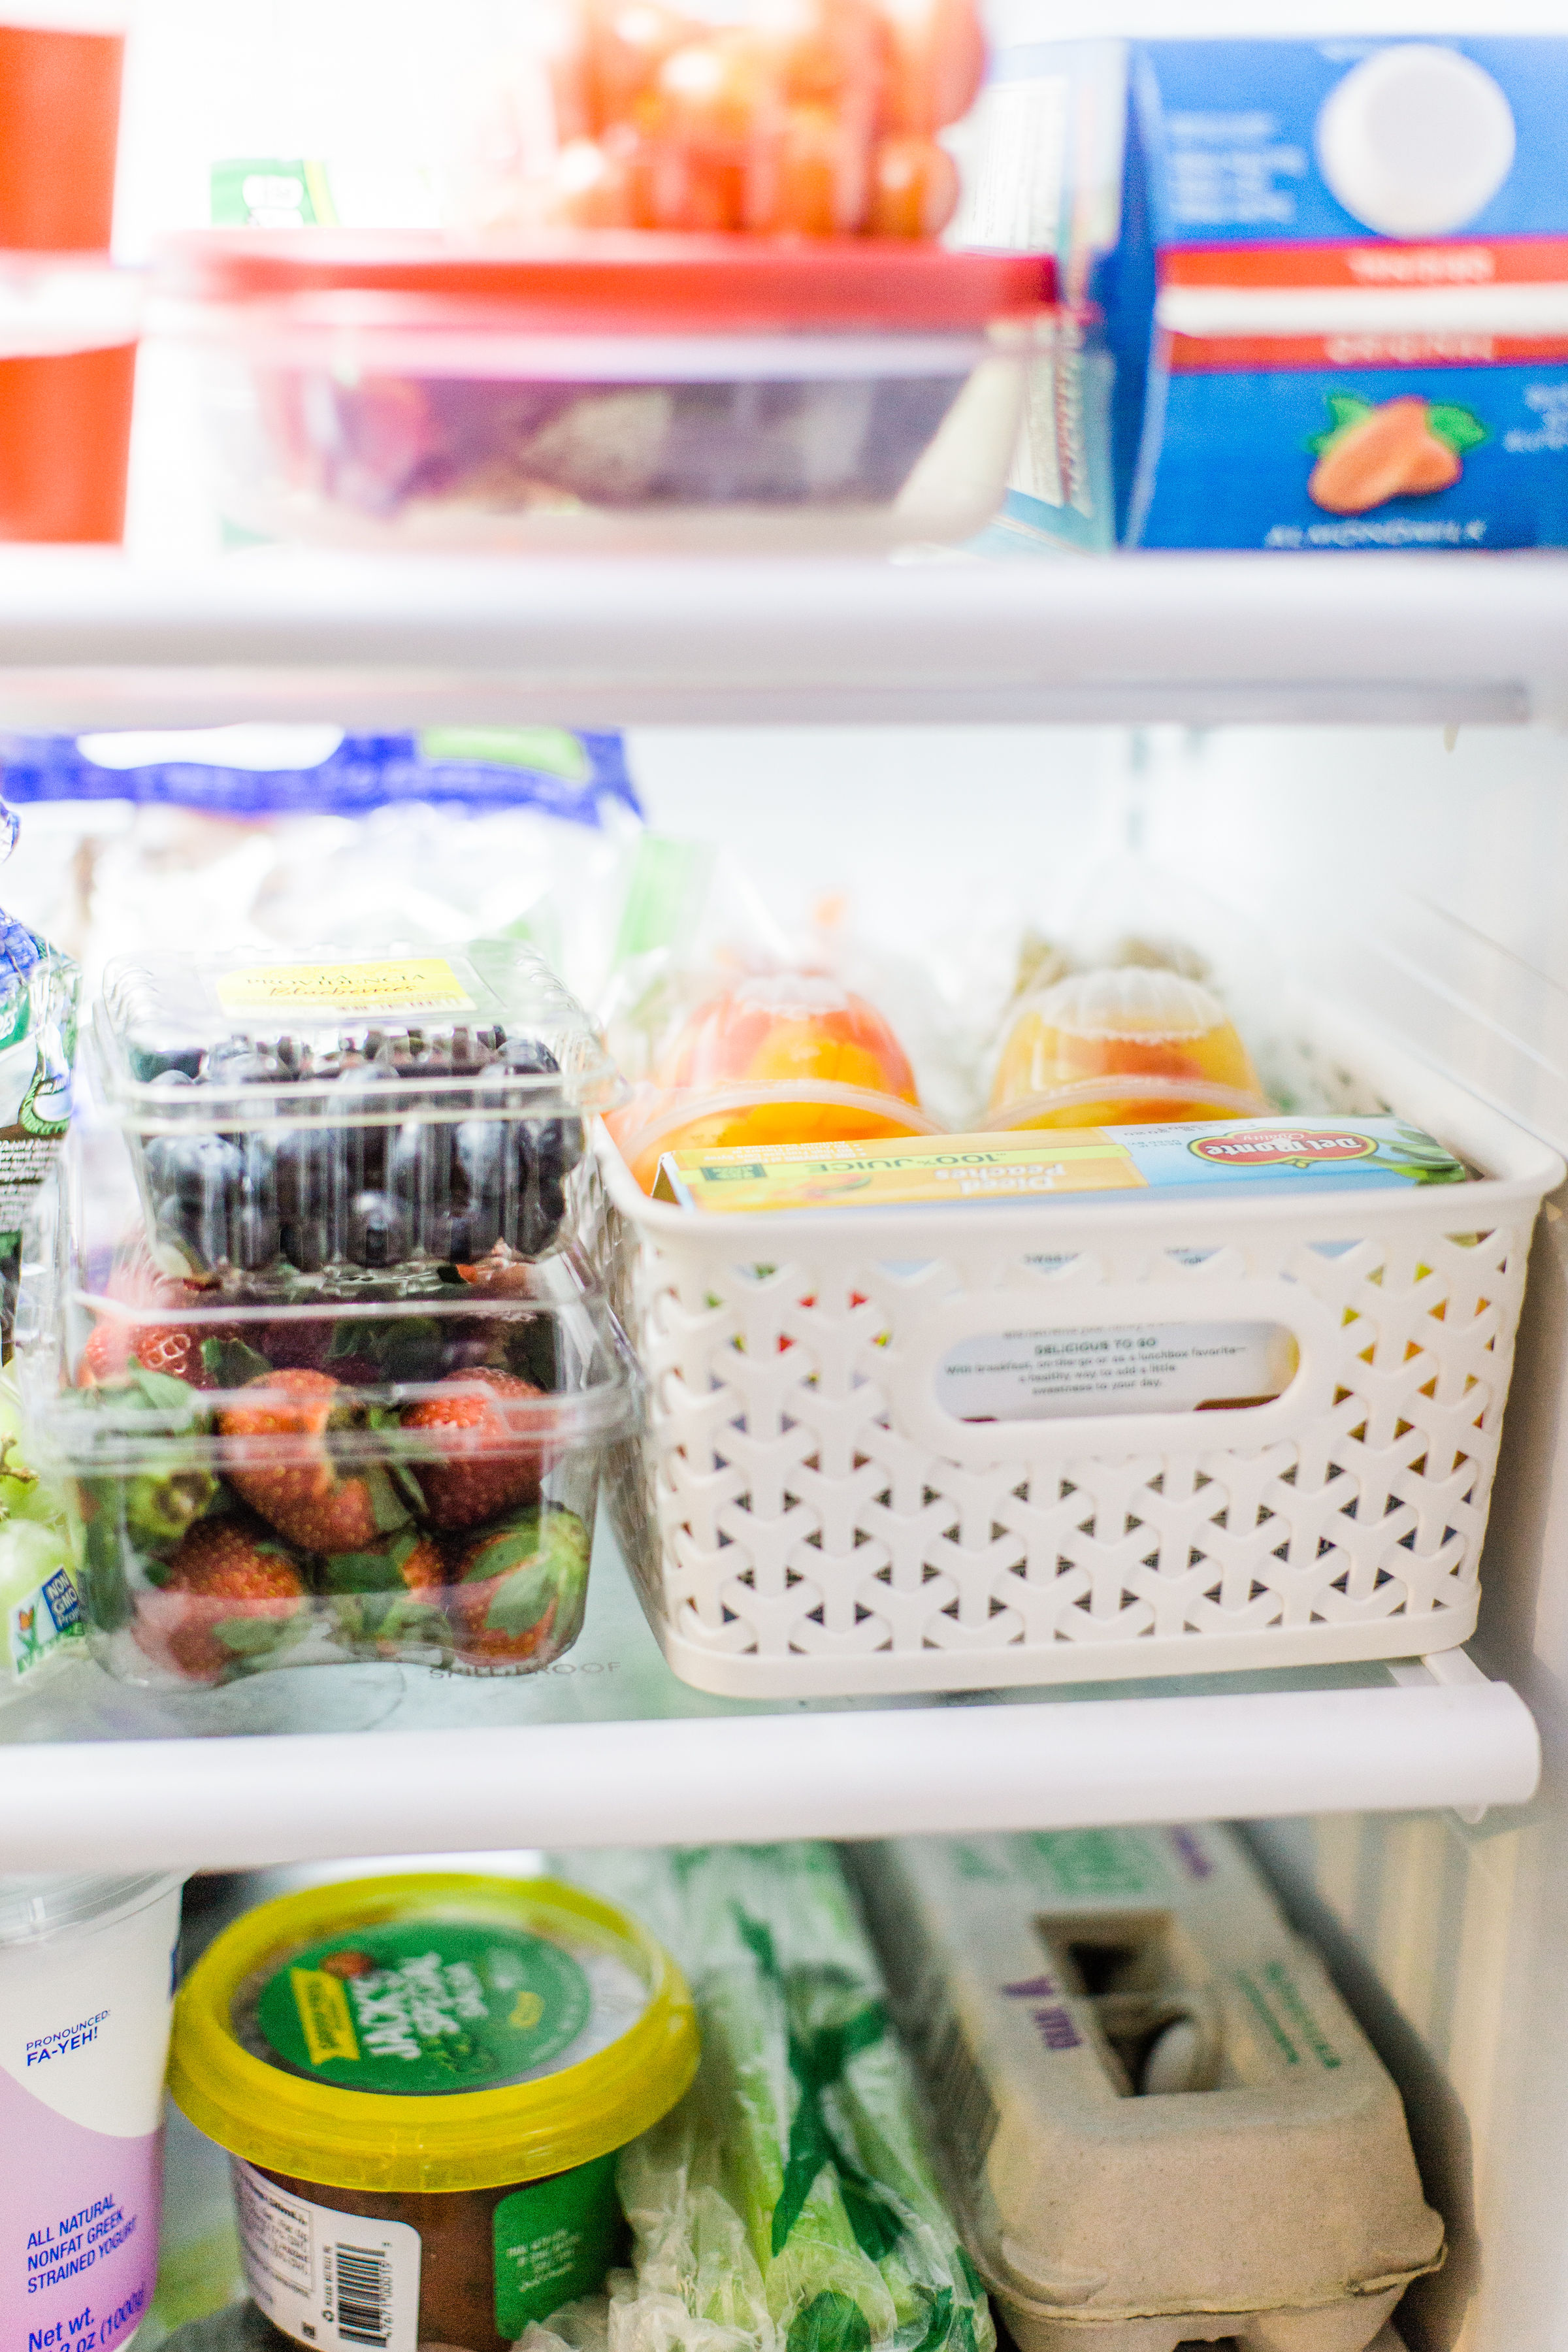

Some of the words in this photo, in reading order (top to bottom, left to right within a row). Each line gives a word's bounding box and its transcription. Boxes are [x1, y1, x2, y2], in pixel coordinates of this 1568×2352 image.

[1204, 1139, 1309, 1155] Monte
[1307, 1137, 1363, 1151] Del
[804, 1158, 914, 1174] JUICE
[934, 1164, 1067, 1181] Peaches
[960, 1175, 1055, 1195] Diced
[1035, 1341, 1109, 1354] DELICIOUS
[1115, 1339, 1132, 1349] TO
[1137, 1337, 1157, 1347] GO
[1138, 1350, 1188, 1360] lunchbox
[1149, 1364, 1177, 1372] little
[1032, 1383, 1092, 1394] sweetness
[46, 1573, 70, 1600] NON
[52, 1587, 78, 1615] GMO
[26, 2009, 110, 2051] PRONOUNCED:
[27, 2026, 98, 2066] FA-YEH!
[27, 2227, 55, 2250] ALL
[59, 2193, 115, 2237] NATURAL
[27, 2233, 84, 2272] NONFAT
[87, 2206, 124, 2244] GREEK
[27, 2249, 95, 2293] STRAINED
[28, 2321, 63, 2352] Net
[69, 2307, 95, 2335] wt.
